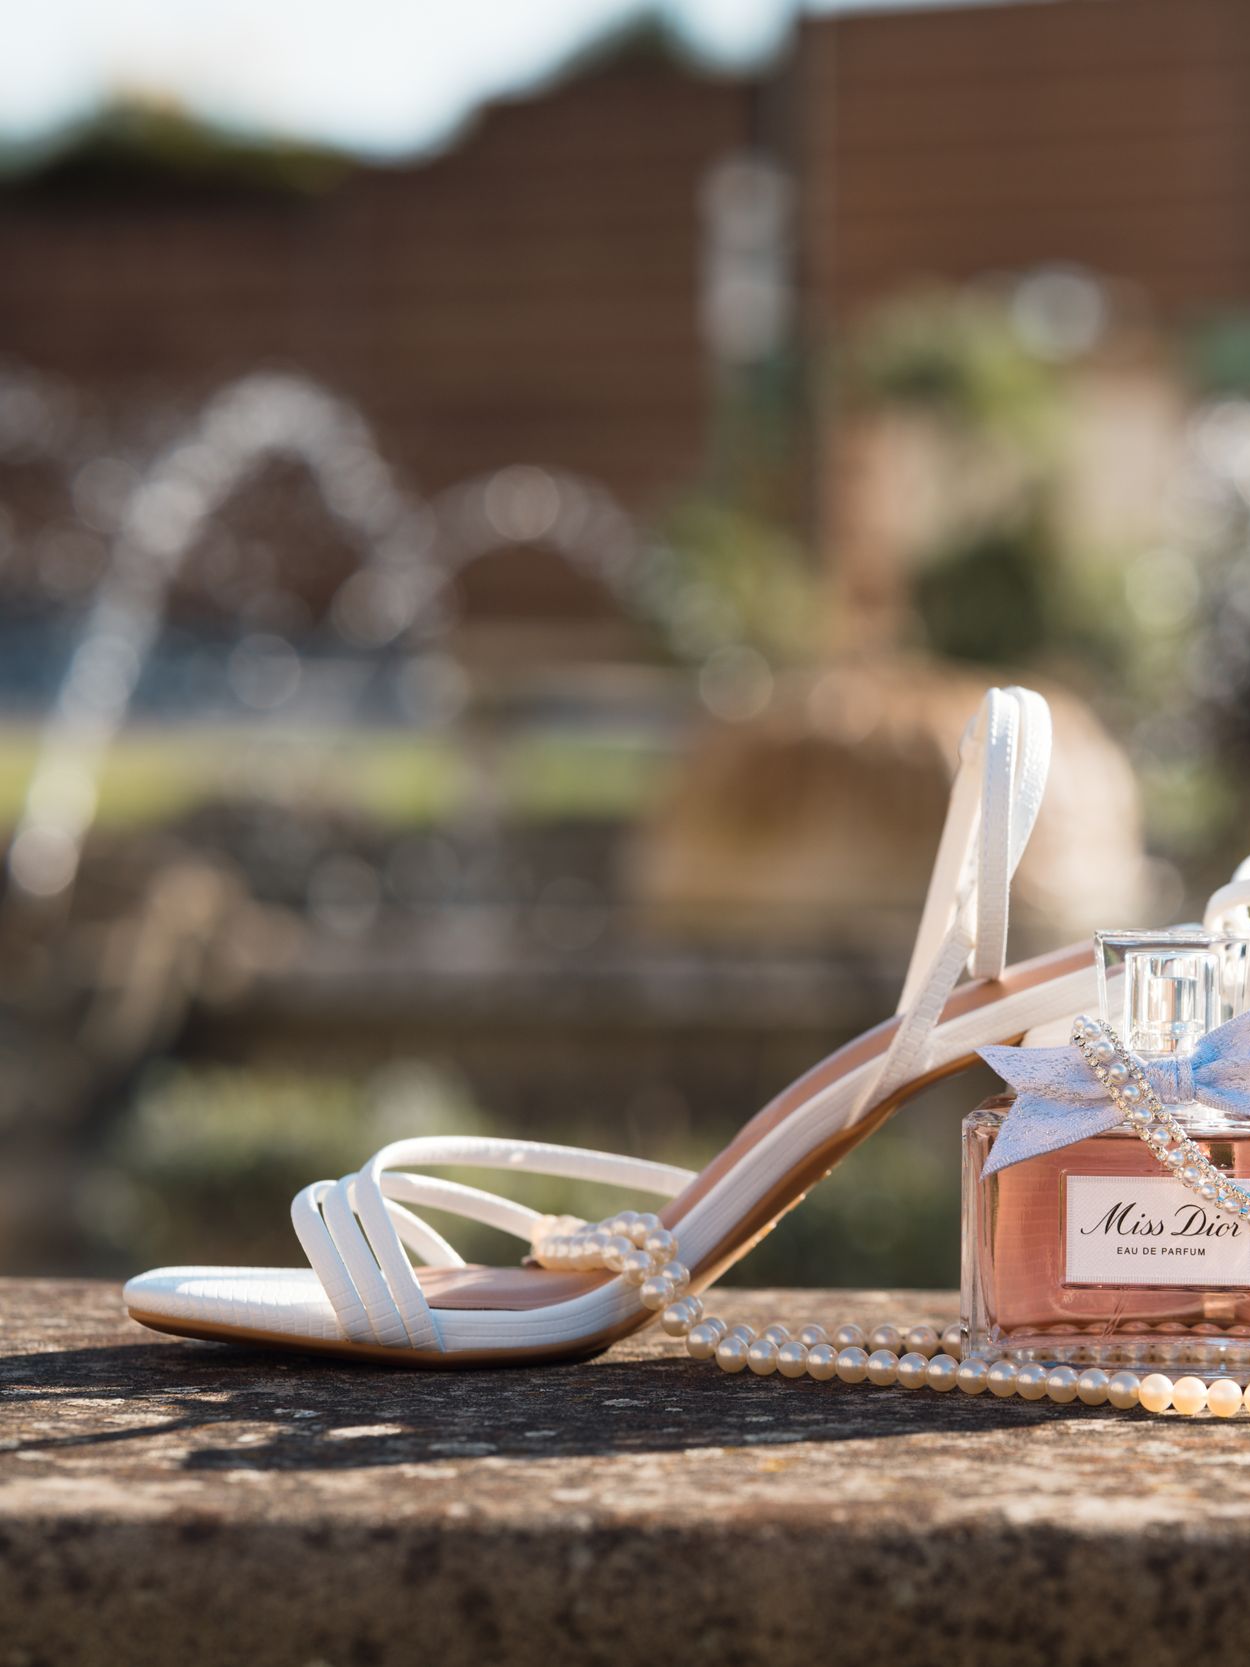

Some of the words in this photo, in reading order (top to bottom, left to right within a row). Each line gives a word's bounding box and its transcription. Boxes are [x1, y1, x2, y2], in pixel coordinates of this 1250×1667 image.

[1080, 1201, 1165, 1236] Miss
[1170, 1204, 1242, 1238] Dior
[1116, 1246, 1139, 1256] EAU
[1142, 1247, 1157, 1256] DE
[1161, 1247, 1206, 1256] PARFUM
